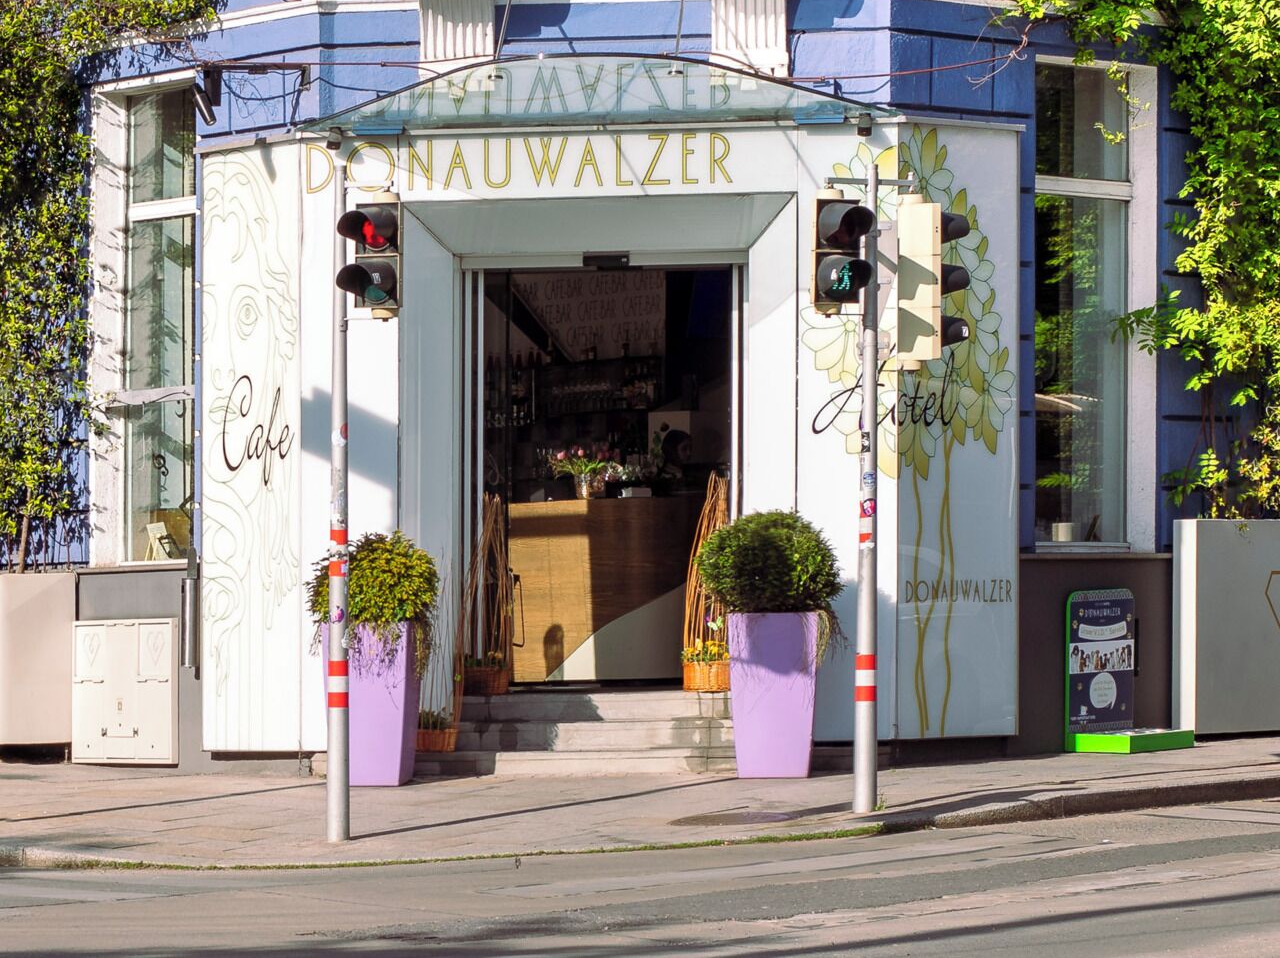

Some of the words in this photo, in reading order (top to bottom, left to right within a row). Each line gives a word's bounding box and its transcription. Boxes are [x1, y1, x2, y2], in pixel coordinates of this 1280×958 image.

[305, 133, 734, 194] DONAUWALZER
[222, 375, 295, 486] Cafe
[905, 579, 1012, 603] DONAUWALZER
